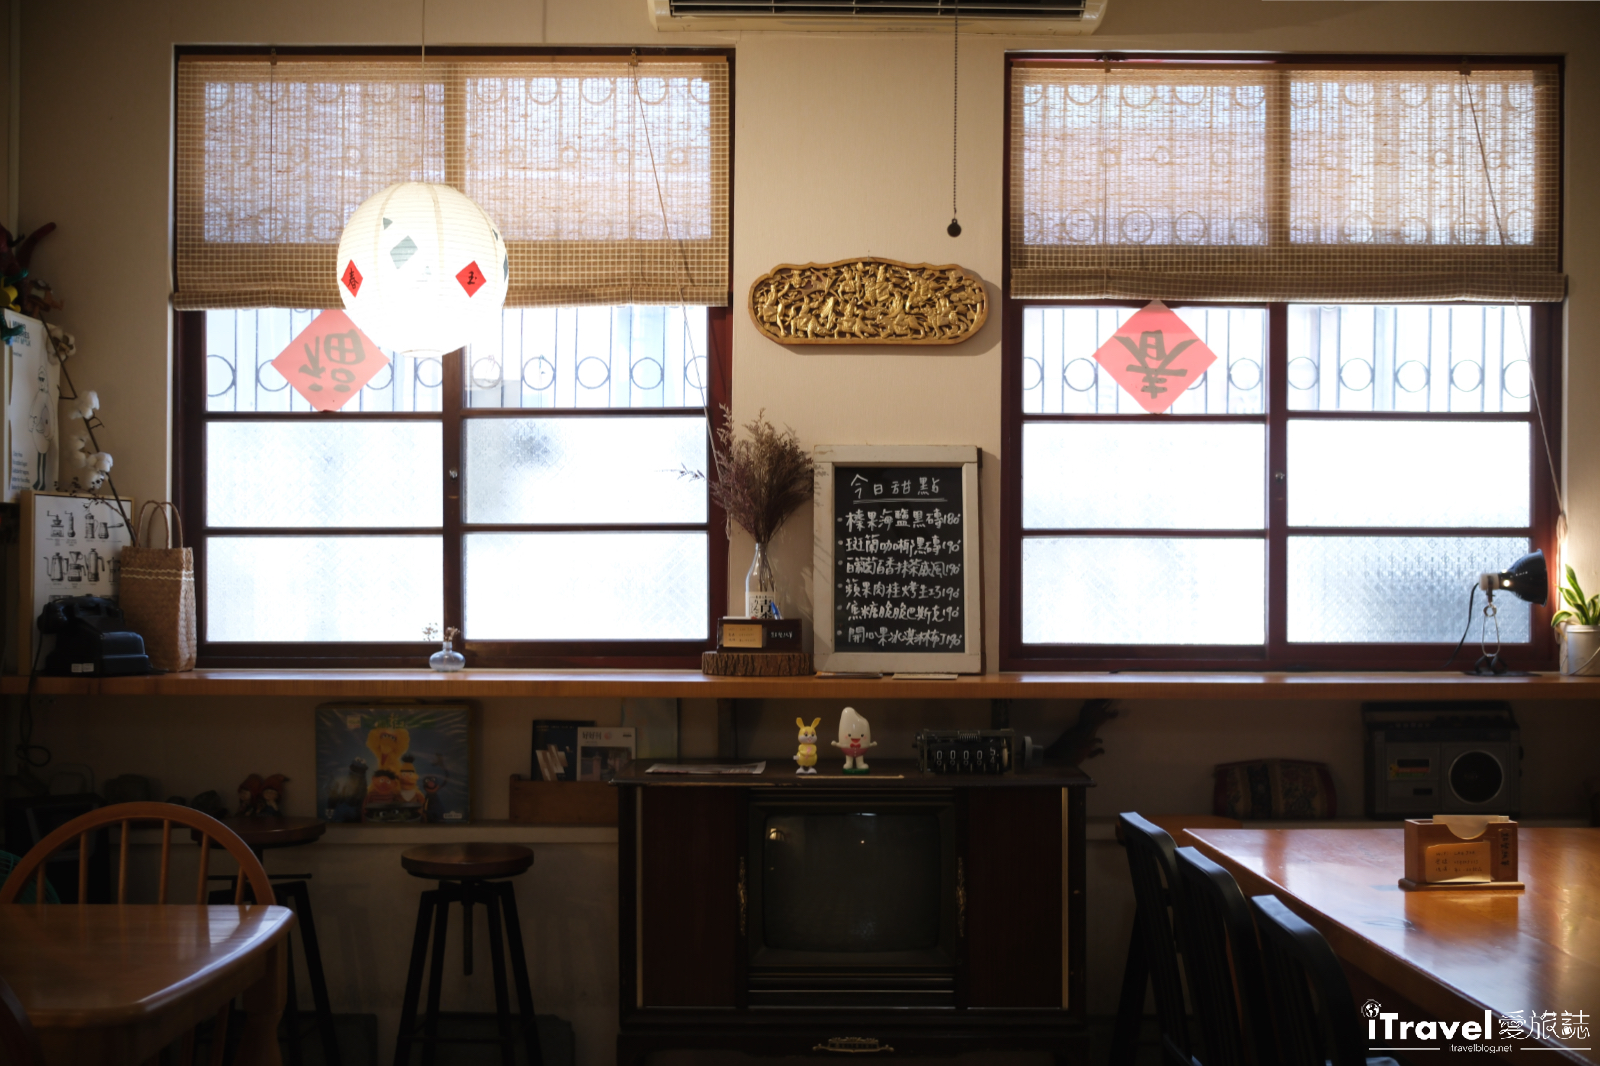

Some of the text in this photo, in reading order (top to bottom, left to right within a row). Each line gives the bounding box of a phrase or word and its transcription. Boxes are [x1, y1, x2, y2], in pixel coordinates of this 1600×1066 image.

[347, 267, 359, 289] 春
[1113, 329, 1199, 399] 春
[850, 473, 940, 499] 今日甜點
